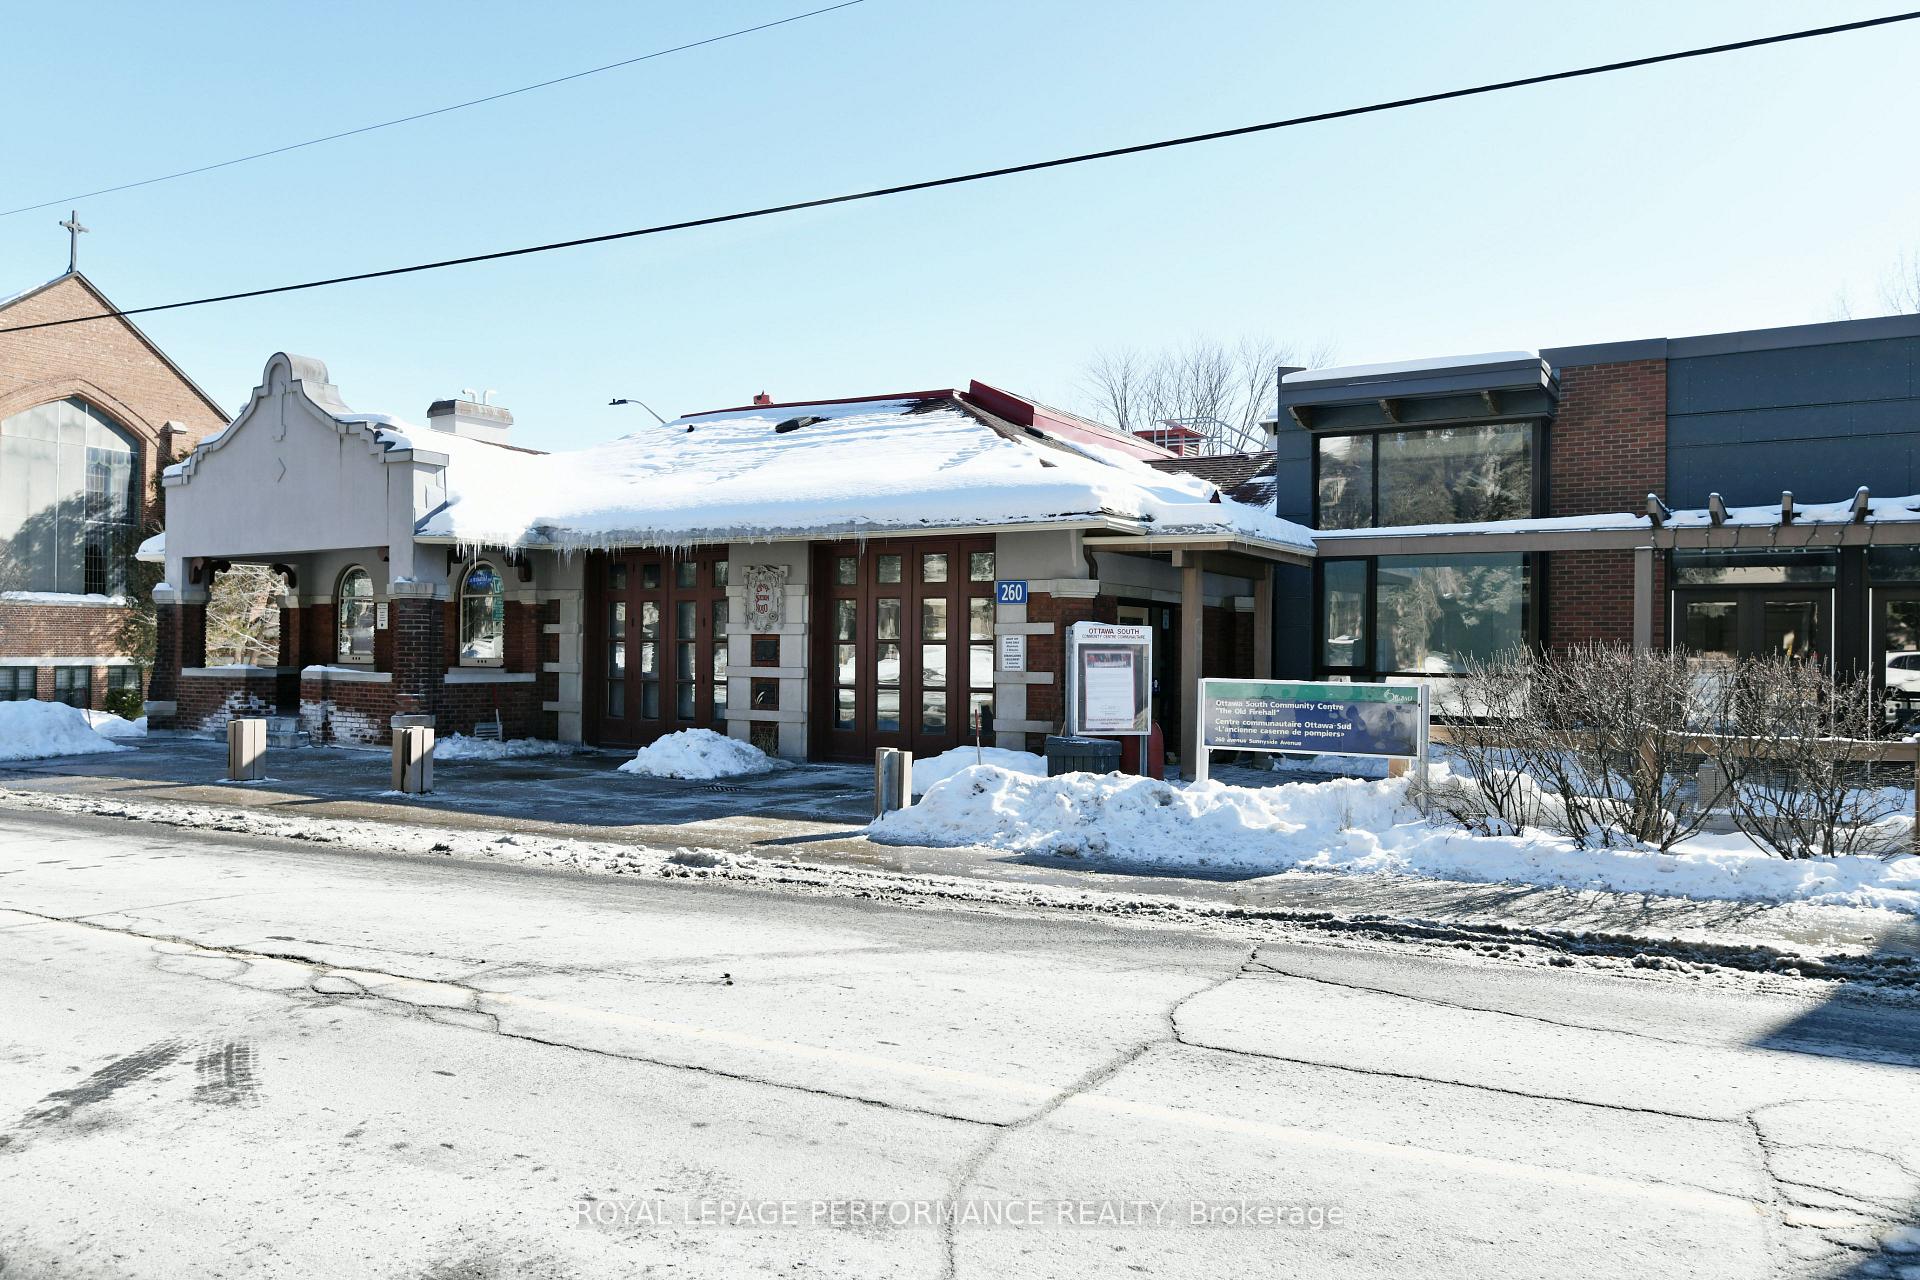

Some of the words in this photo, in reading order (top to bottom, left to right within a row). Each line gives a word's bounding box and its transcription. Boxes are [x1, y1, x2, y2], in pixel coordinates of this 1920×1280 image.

[1001, 584, 1023, 601] 260
[1245, 701, 1268, 709] South
[1270, 701, 1315, 711] Community
[1317, 703, 1344, 711] Centre
[1242, 720, 1302, 728] communautaire
